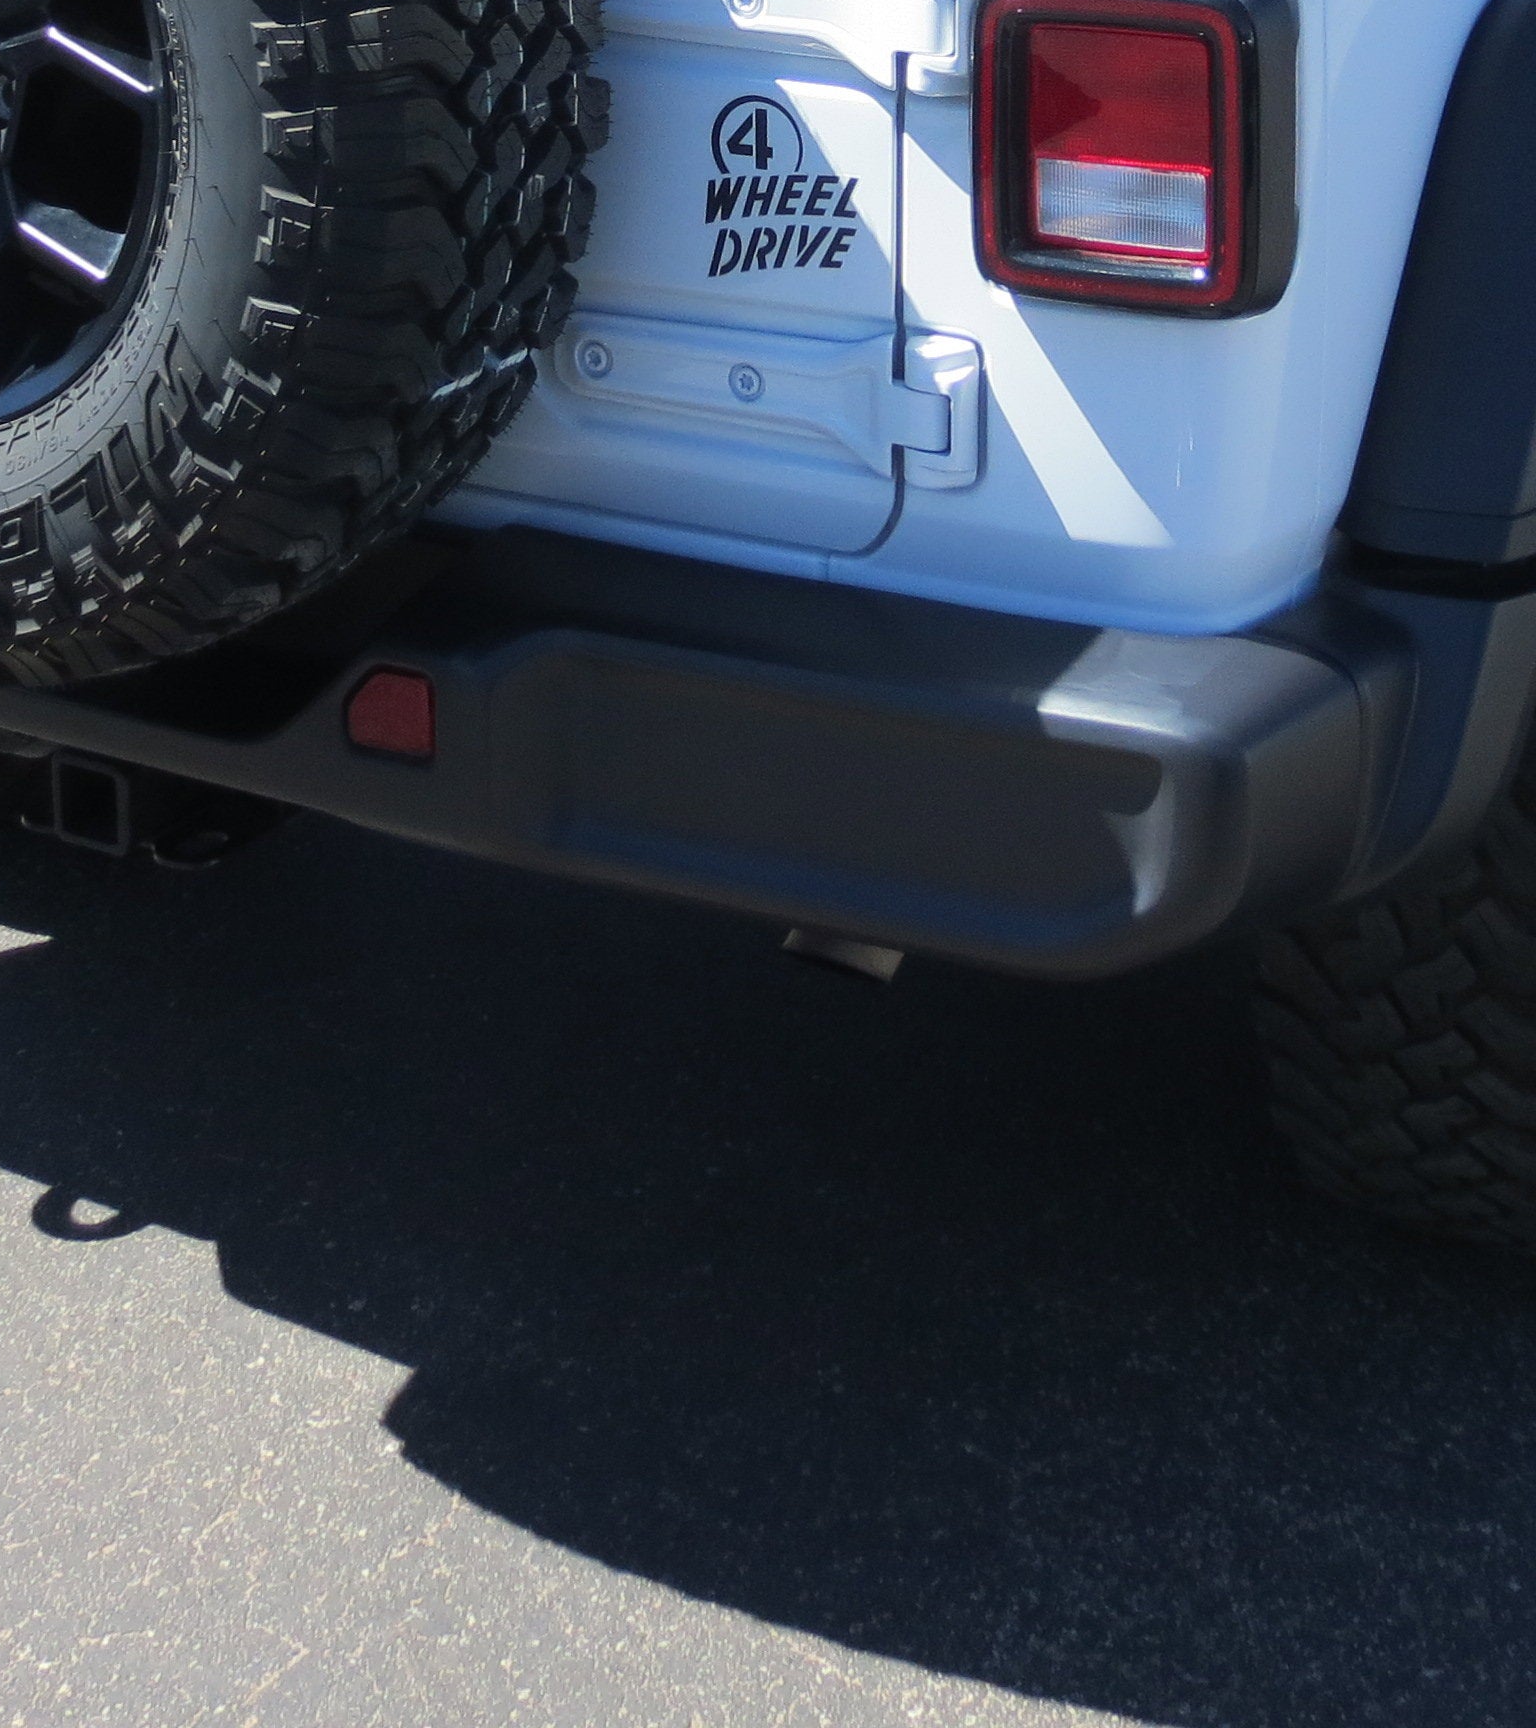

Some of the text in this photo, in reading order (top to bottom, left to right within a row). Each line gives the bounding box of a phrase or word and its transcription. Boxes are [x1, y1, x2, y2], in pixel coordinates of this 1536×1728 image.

[726, 108, 774, 170] 4
[704, 174, 859, 224] WHEEL
[707, 224, 858, 278] DRIVE
